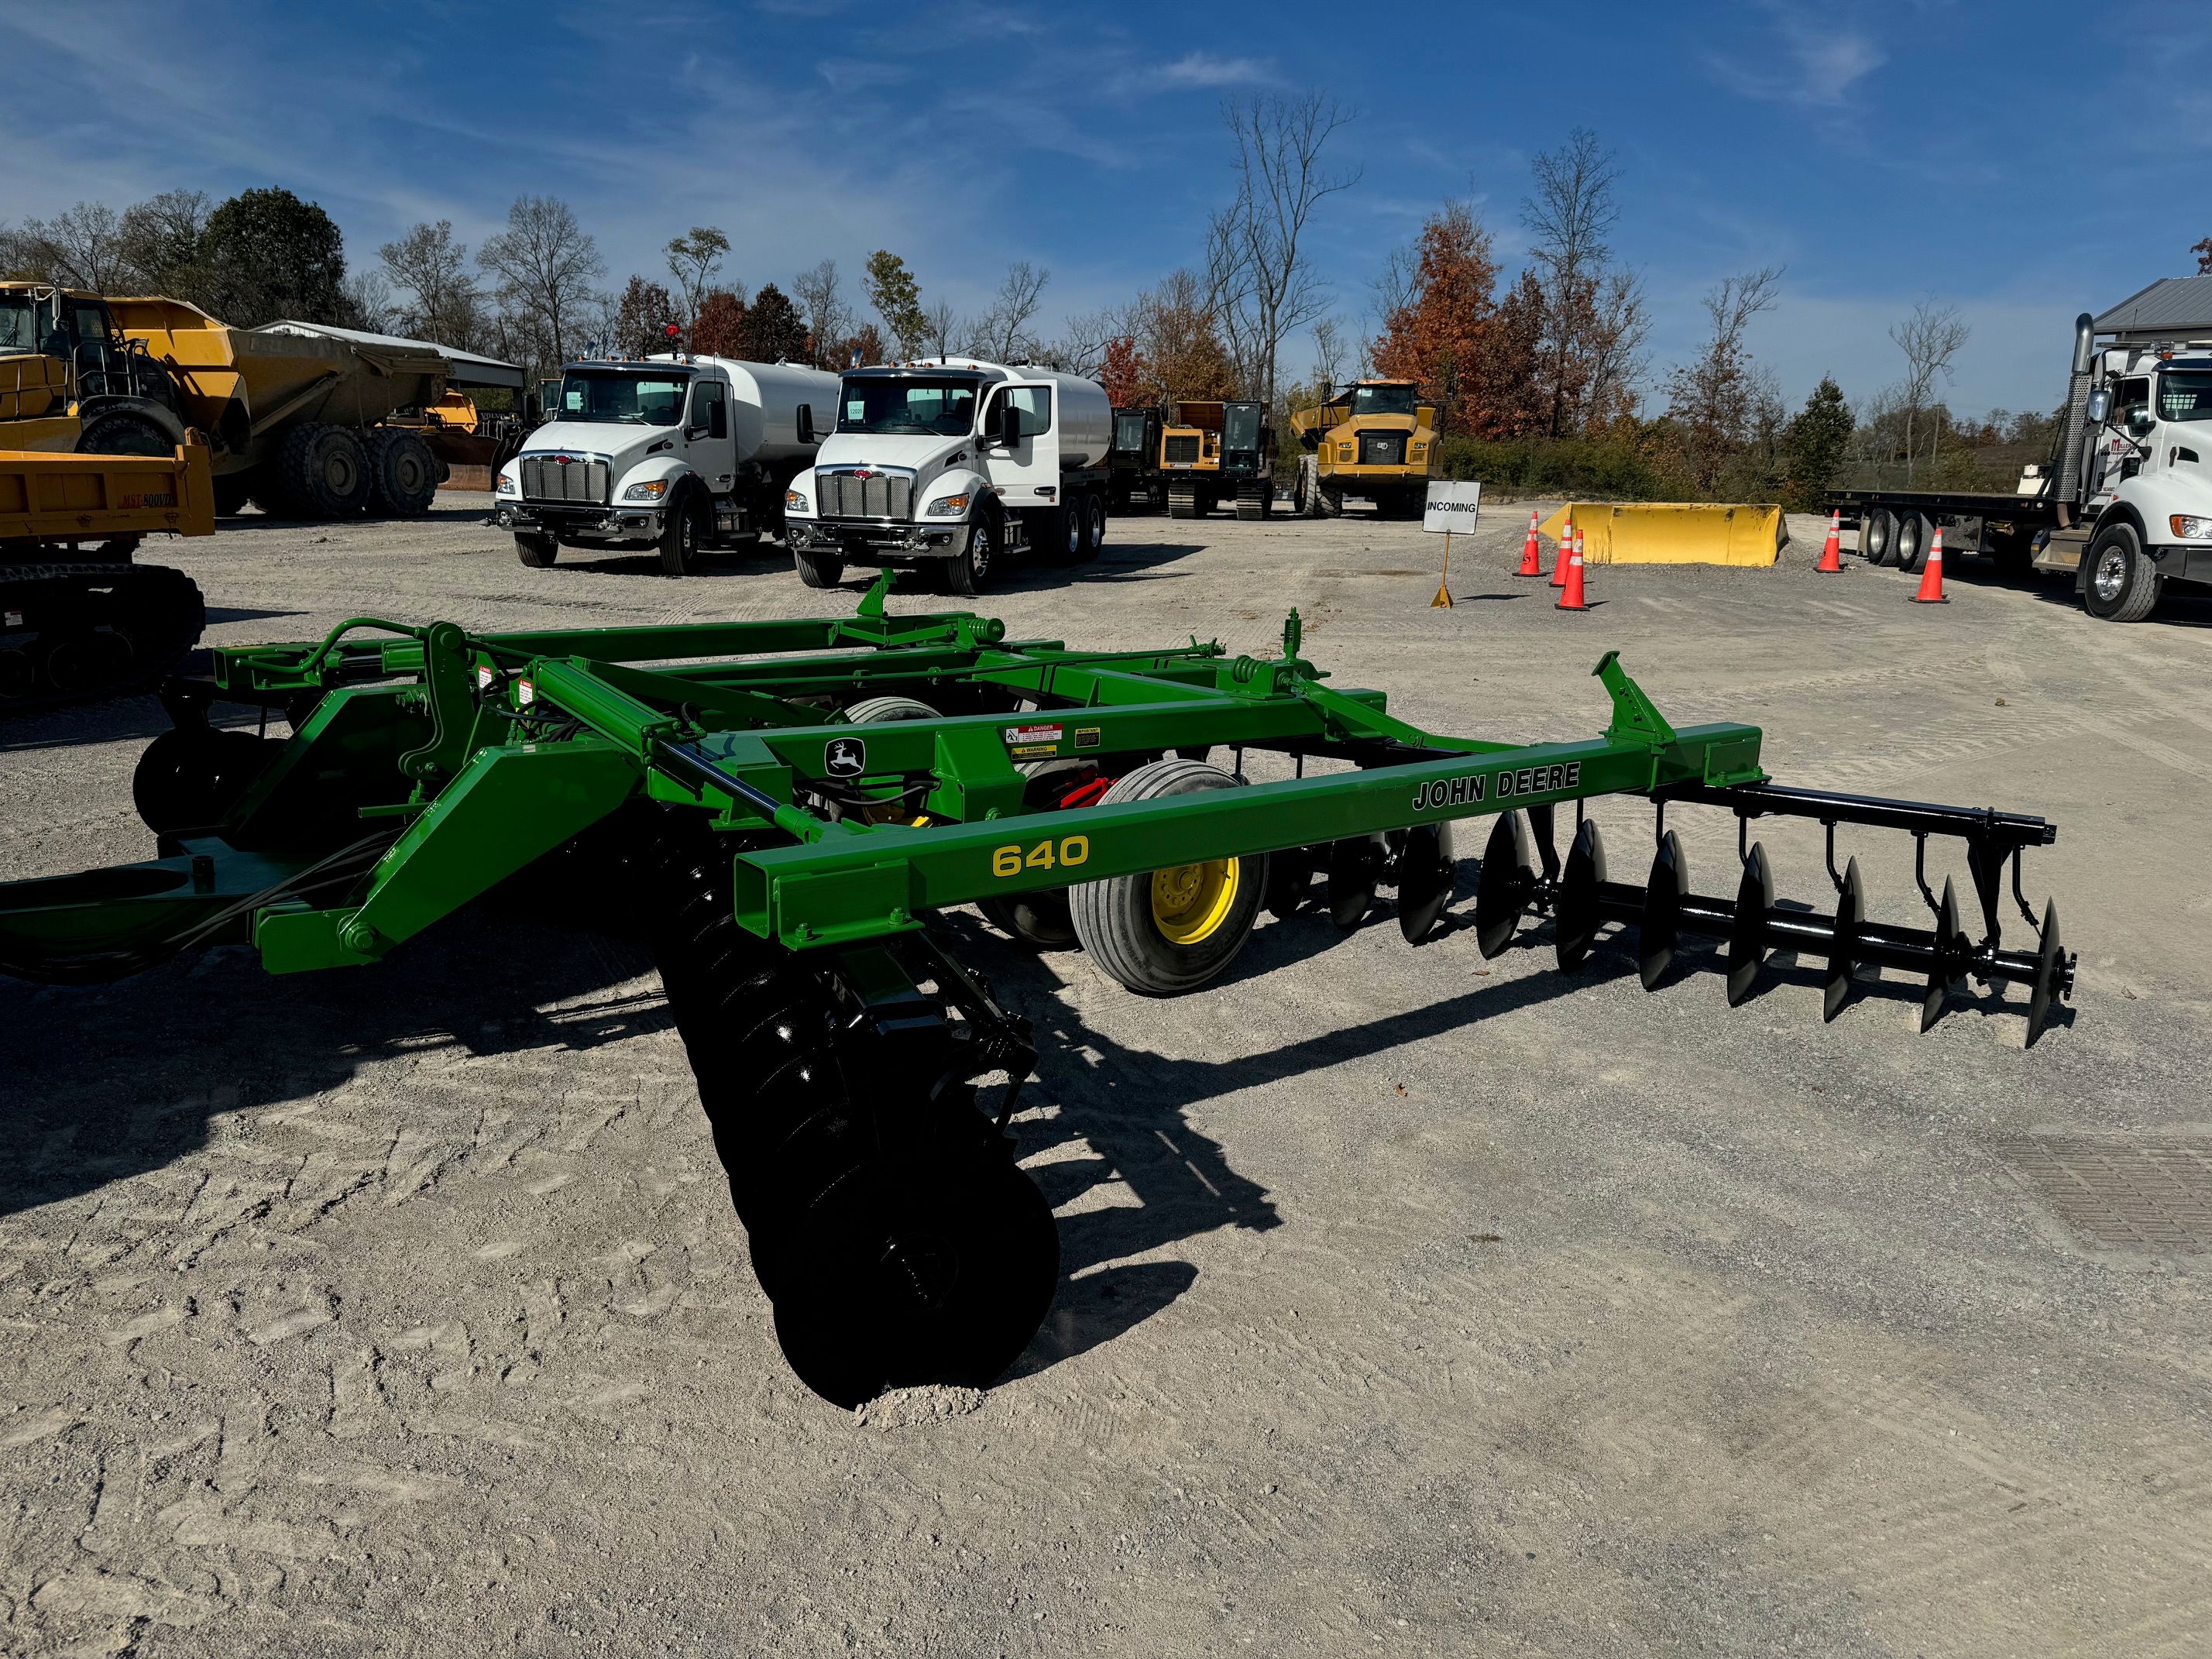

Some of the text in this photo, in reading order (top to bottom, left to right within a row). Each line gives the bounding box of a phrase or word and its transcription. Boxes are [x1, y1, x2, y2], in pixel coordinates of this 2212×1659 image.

[2111, 439, 2131, 452] MILLER
[1427, 501, 1476, 513] INCOMING
[1412, 761, 1581, 811] JOHN DEERE
[992, 834, 1089, 878] 640
